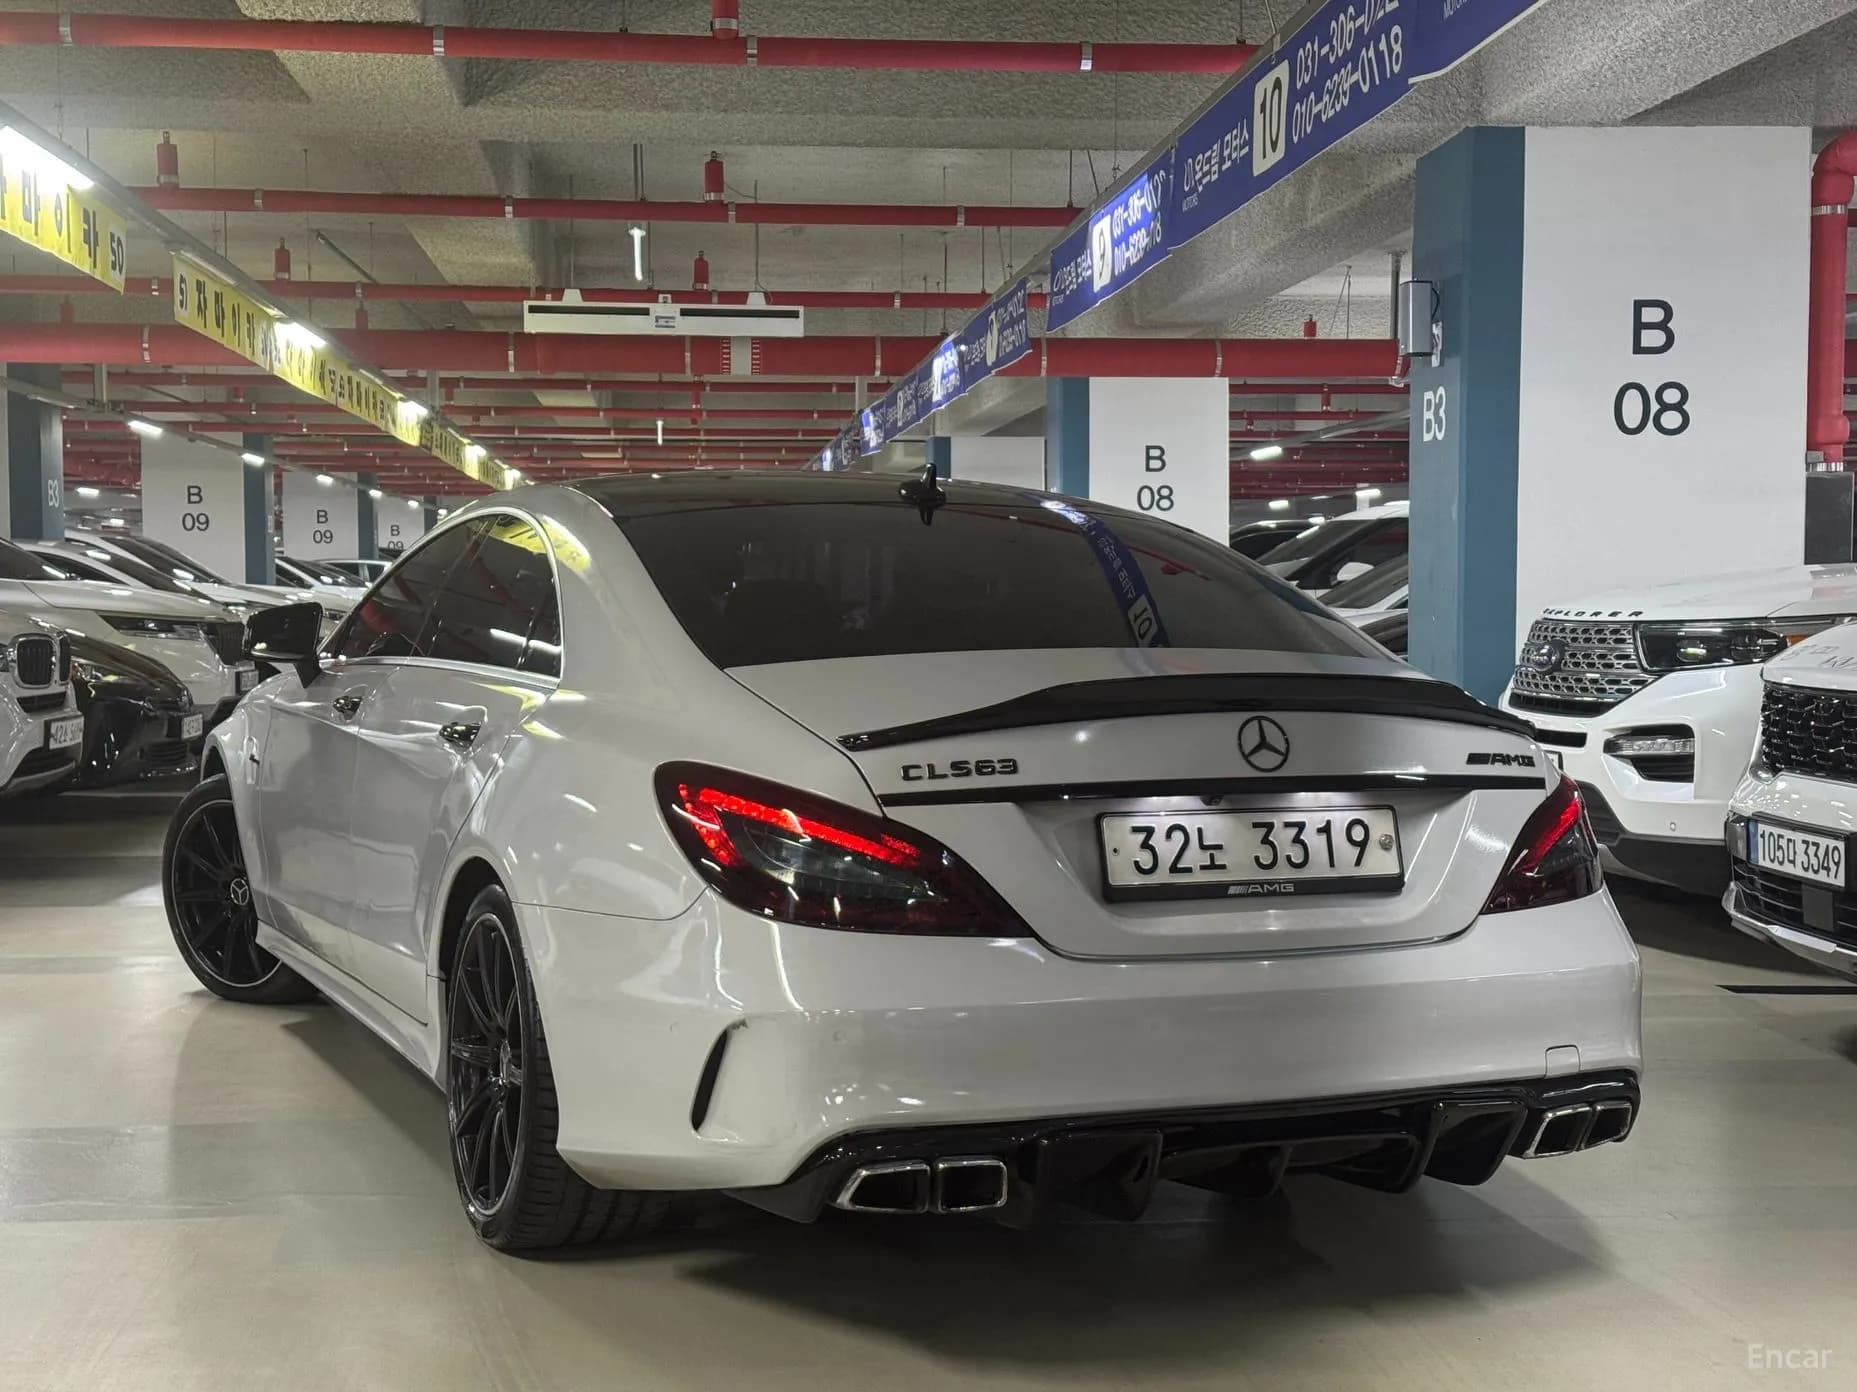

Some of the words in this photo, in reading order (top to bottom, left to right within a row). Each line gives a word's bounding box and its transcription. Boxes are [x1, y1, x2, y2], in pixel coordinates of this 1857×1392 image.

[1292, 25, 1403, 144] 010-6239-0118
[1259, 76, 1283, 160] 10
[1195, 138, 1221, 193] 온드림
[1222, 117, 1250, 165] 모터스
[108, 230, 125, 276] 50
[1632, 298, 1676, 356] B
[1422, 386, 1447, 442] B3
[1613, 381, 1691, 437] 08
[1145, 445, 1167, 472] B
[47, 479, 60, 508] B3
[186, 485, 204, 505] B
[1137, 485, 1174, 511] 08
[181, 513, 210, 532] 09
[316, 509, 329, 524] B
[390, 524, 401, 537] B
[312, 530, 334, 544] 09
[900, 758, 1019, 782] CLS63
[1490, 752, 1537, 768] AMG
[1131, 823, 1228, 876] 32노
[1251, 817, 1371, 871] 3319
[1759, 829, 1798, 869] 105다
[1800, 839, 1842, 880] 3349
[1247, 883, 1295, 894] AMG
